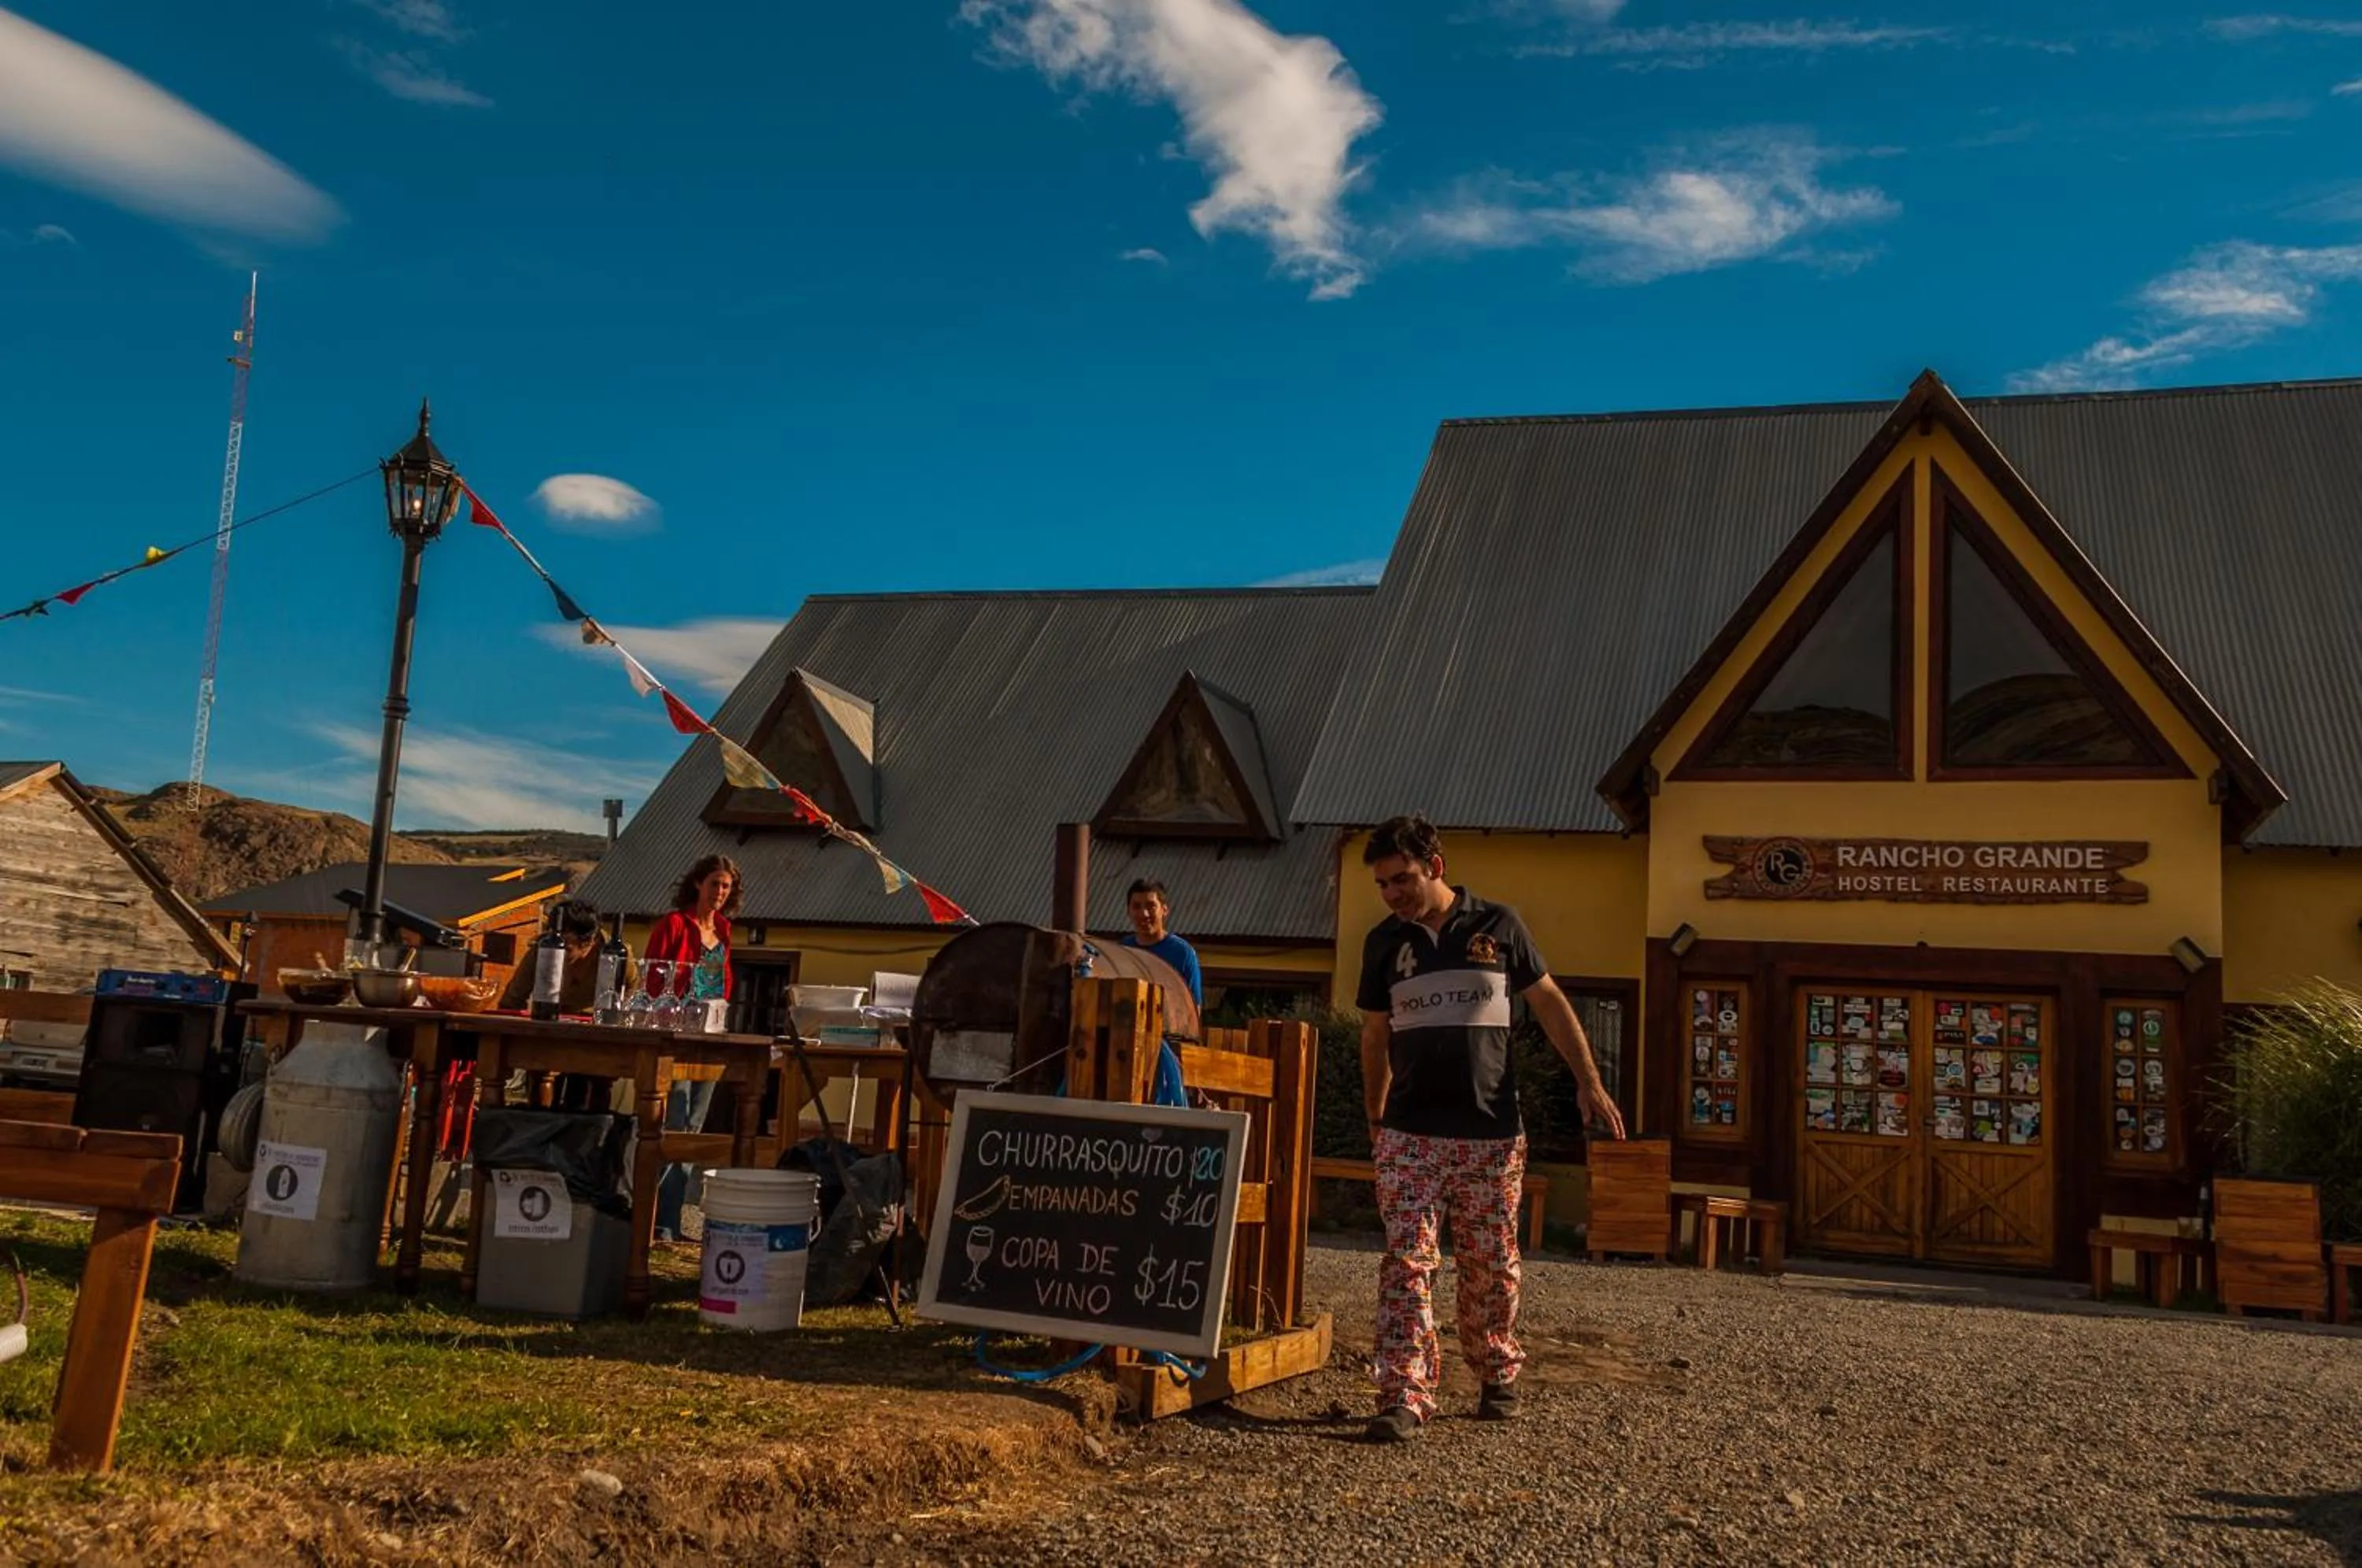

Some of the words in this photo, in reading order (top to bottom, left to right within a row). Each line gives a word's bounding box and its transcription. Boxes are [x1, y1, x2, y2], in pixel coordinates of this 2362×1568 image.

[1837, 845, 1965, 868] RANCHO
[1973, 846, 2105, 870] GRANDE
[1838, 875, 1923, 893] HOSTEL
[1942, 875, 2109, 894] RESTAURANTE
[1395, 941, 1417, 978] 4
[1446, 986, 1494, 1004] TEAM
[977, 1129, 1183, 1180] CHURRASQUITO
[1008, 1183, 1141, 1217] EMPANADAS
[1159, 1185, 1218, 1228] $10
[1001, 1236, 1060, 1271] COPA
[1075, 1241, 1120, 1277] DE
[1034, 1278, 1112, 1315] VINO
[1134, 1243, 1205, 1311] $15
